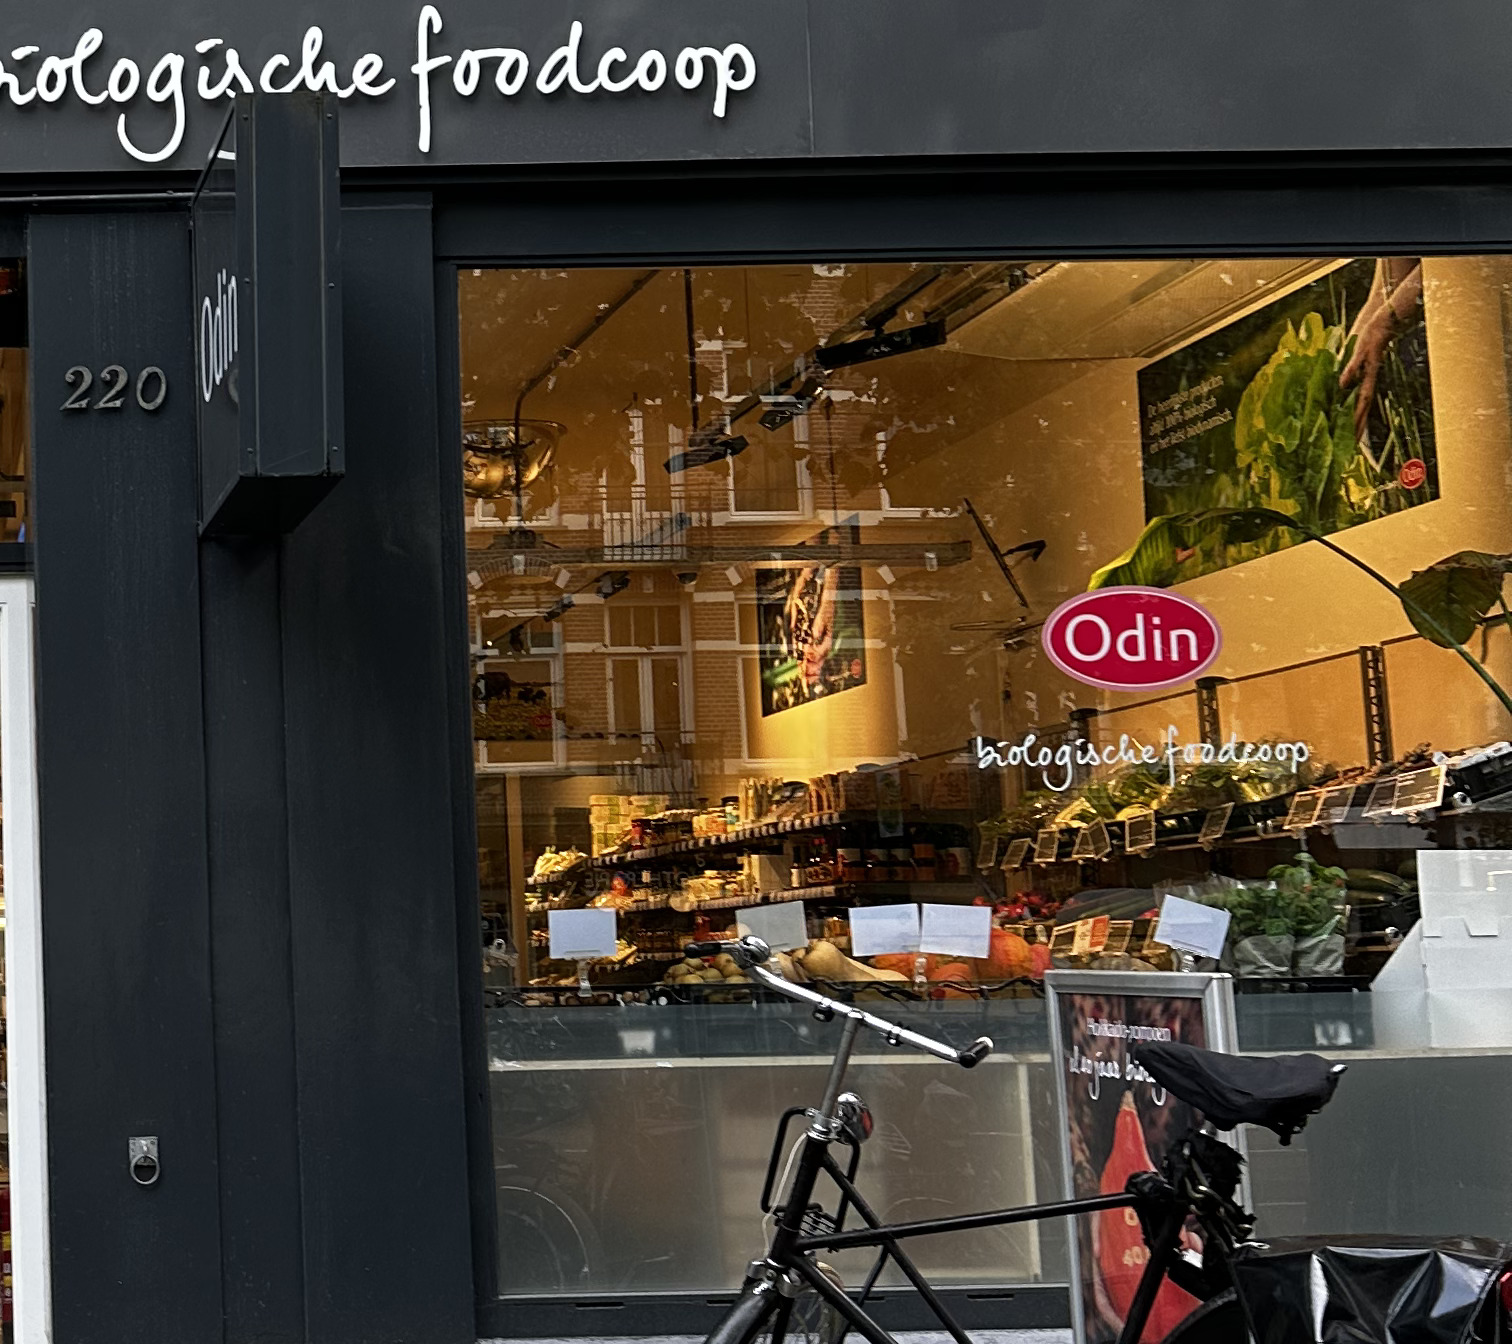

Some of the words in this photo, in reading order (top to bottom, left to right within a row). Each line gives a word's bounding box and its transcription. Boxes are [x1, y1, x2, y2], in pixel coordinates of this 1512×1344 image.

[409, 4, 757, 153] foodcoop
[200, 268, 238, 403] Odin
[59, 364, 168, 411] 220
[1065, 612, 1199, 662] Odin
[976, 733, 1159, 792] biologische
[1163, 724, 1310, 788] foodcoop
